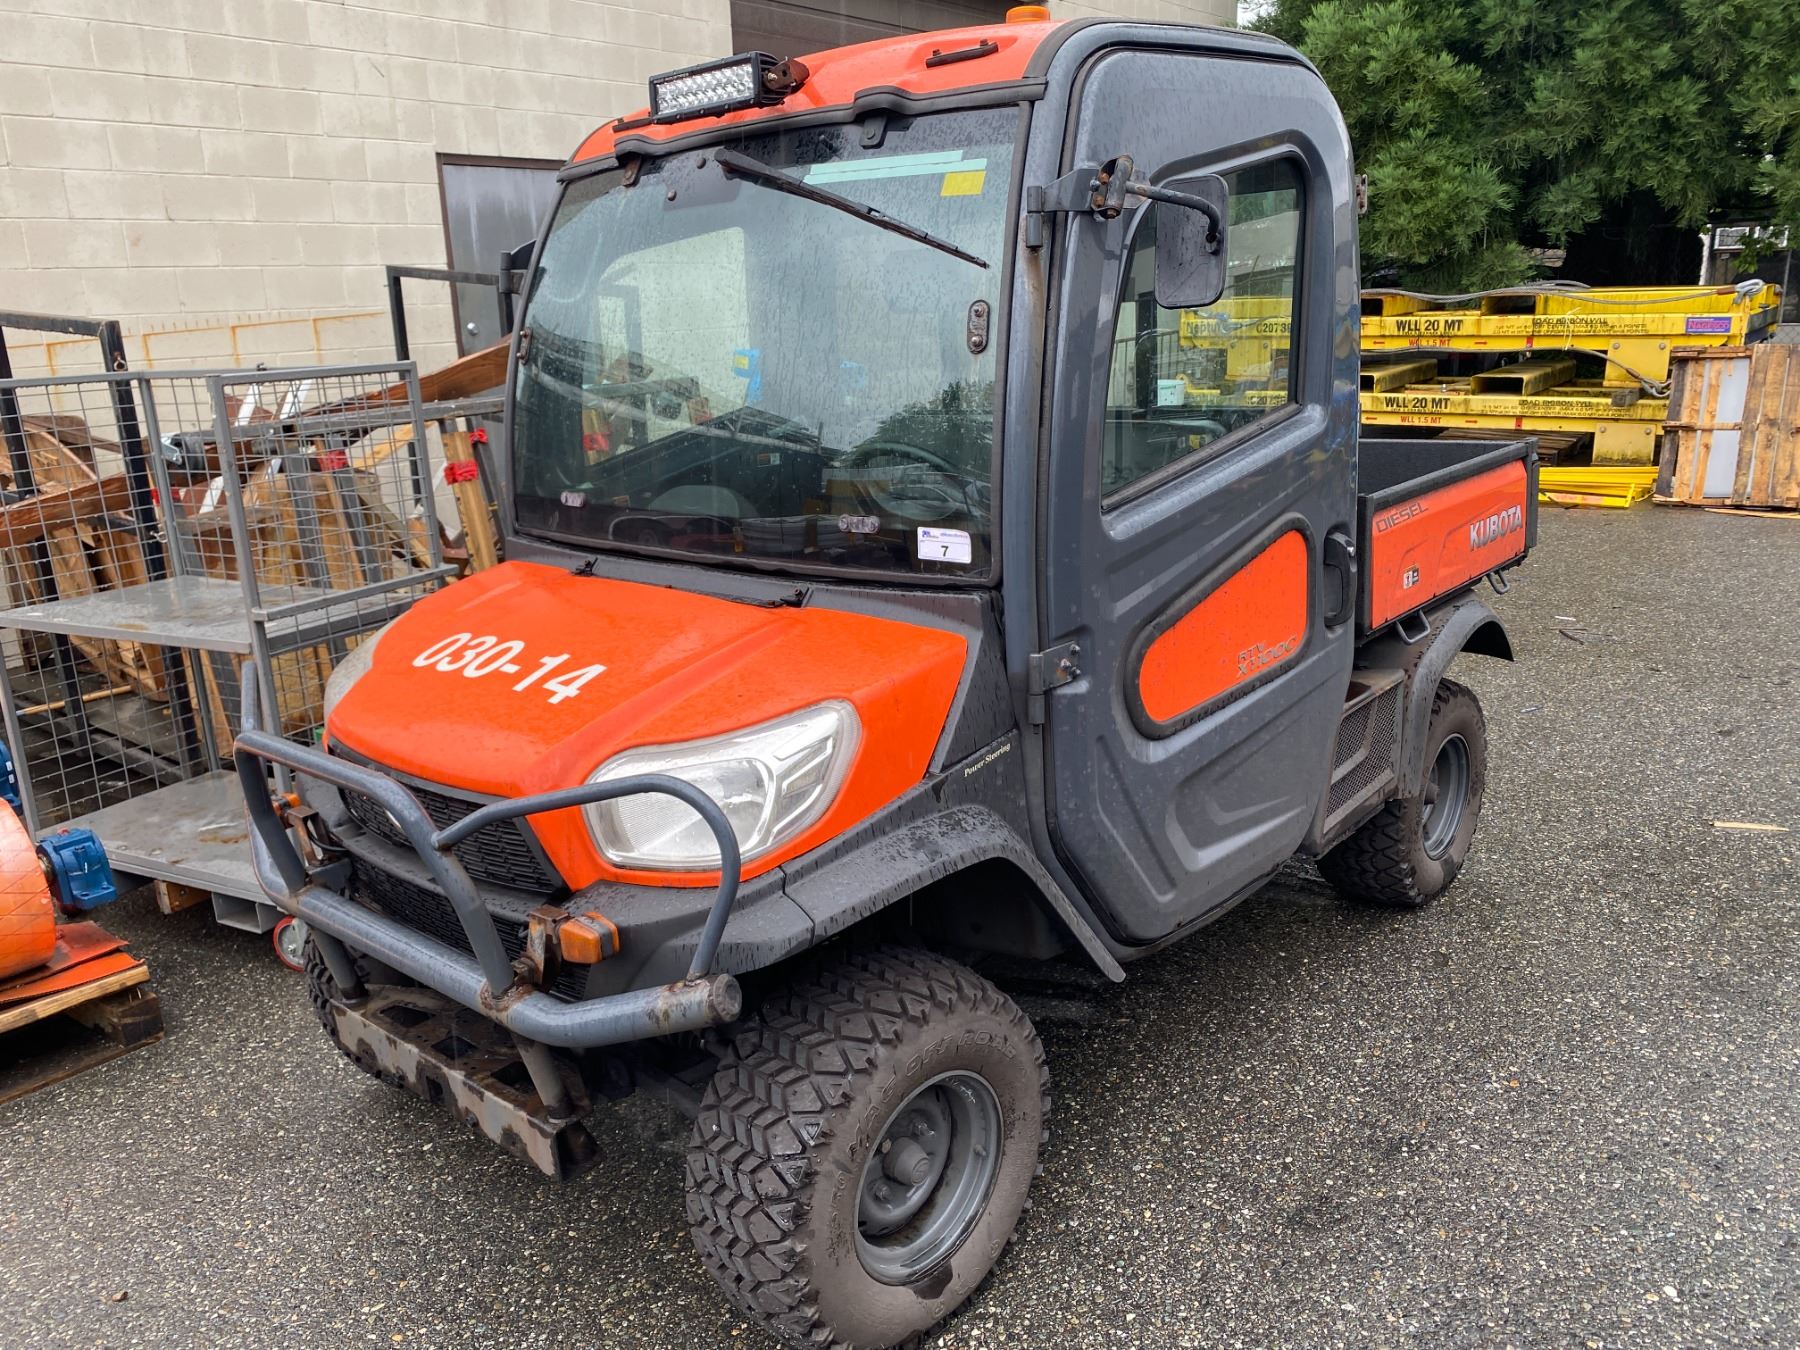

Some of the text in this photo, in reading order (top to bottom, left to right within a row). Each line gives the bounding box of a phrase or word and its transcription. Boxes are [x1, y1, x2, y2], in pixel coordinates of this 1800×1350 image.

[1396, 319, 1463, 332] WLL 20 MT
[1440, 339, 1451, 347] MT
[1385, 397, 1450, 410] WLL 20 MT
[1376, 502, 1429, 533] DIESEL
[1469, 505, 1523, 551] KUBOTA
[941, 545, 949, 557] 7
[412, 632, 608, 705] 030-14
[964, 743, 1011, 777] Power Steering
